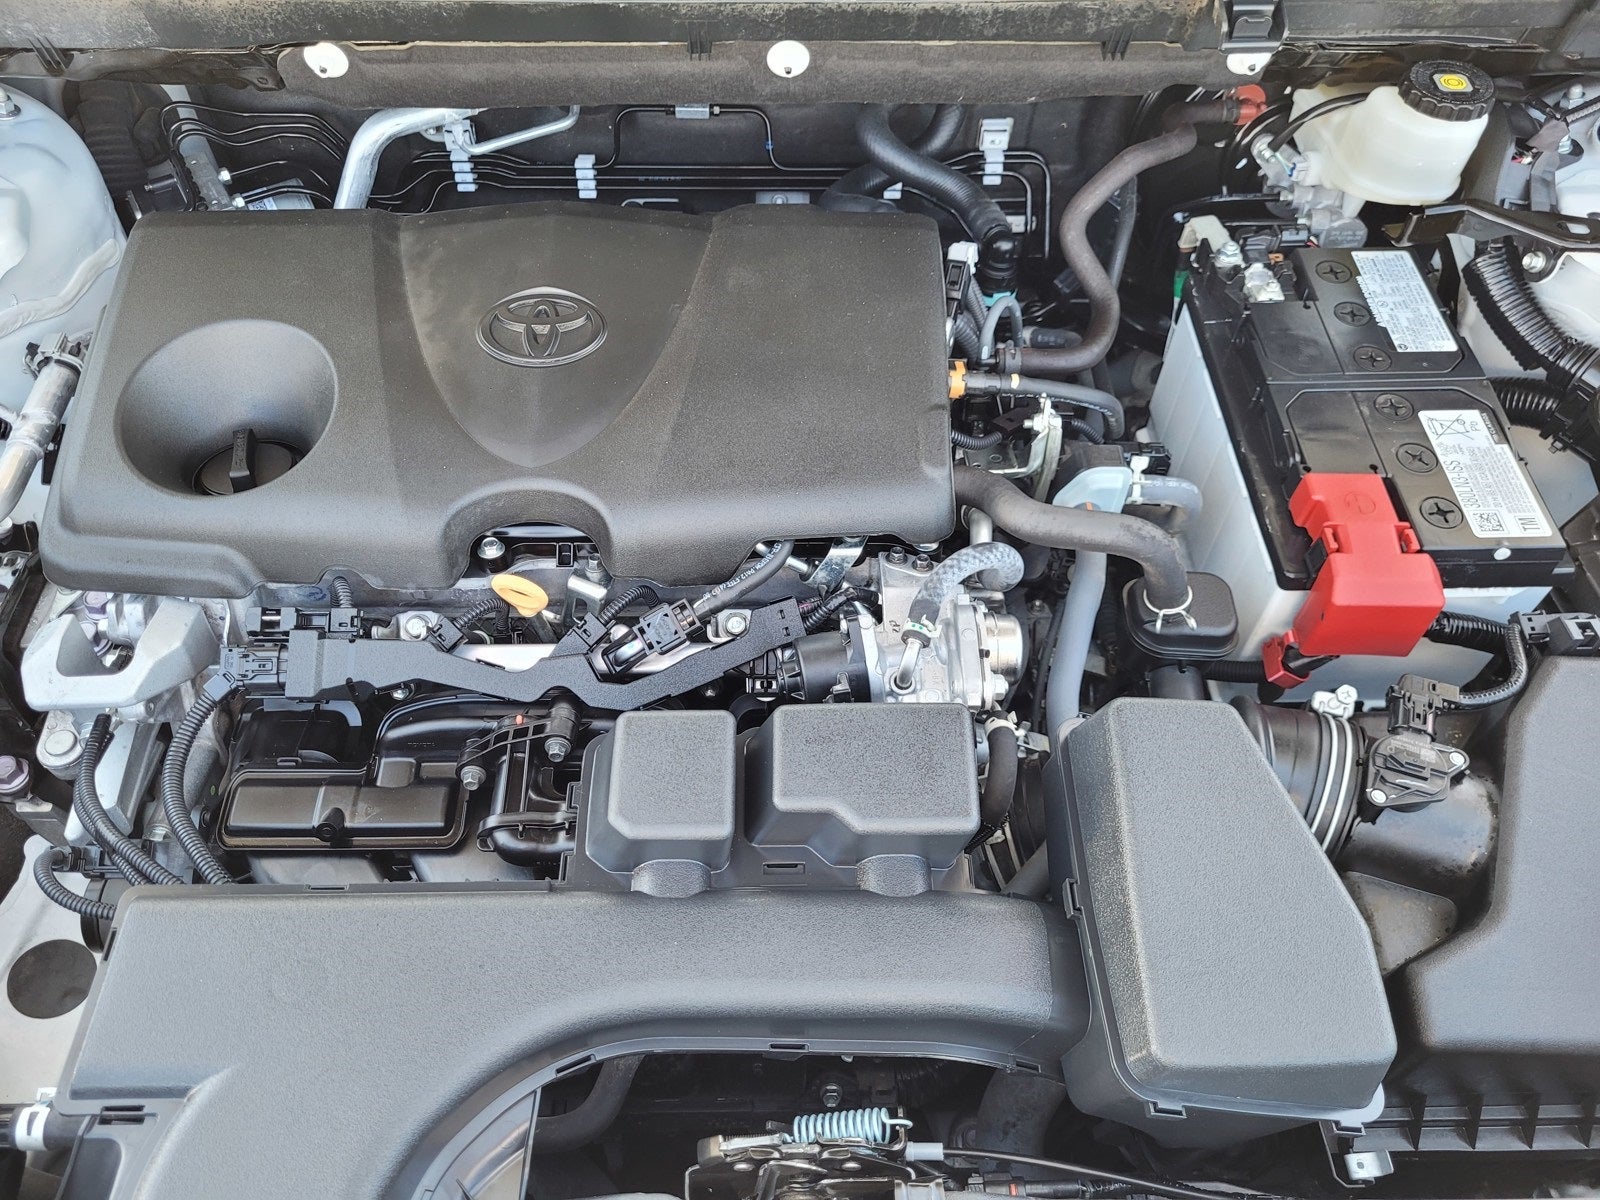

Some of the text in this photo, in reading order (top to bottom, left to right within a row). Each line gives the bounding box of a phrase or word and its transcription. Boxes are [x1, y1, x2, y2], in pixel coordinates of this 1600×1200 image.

[1470, 421, 1481, 431] Pb
[1443, 460, 1482, 509] 380LN3-ISS
[1518, 517, 1541, 532] TM
